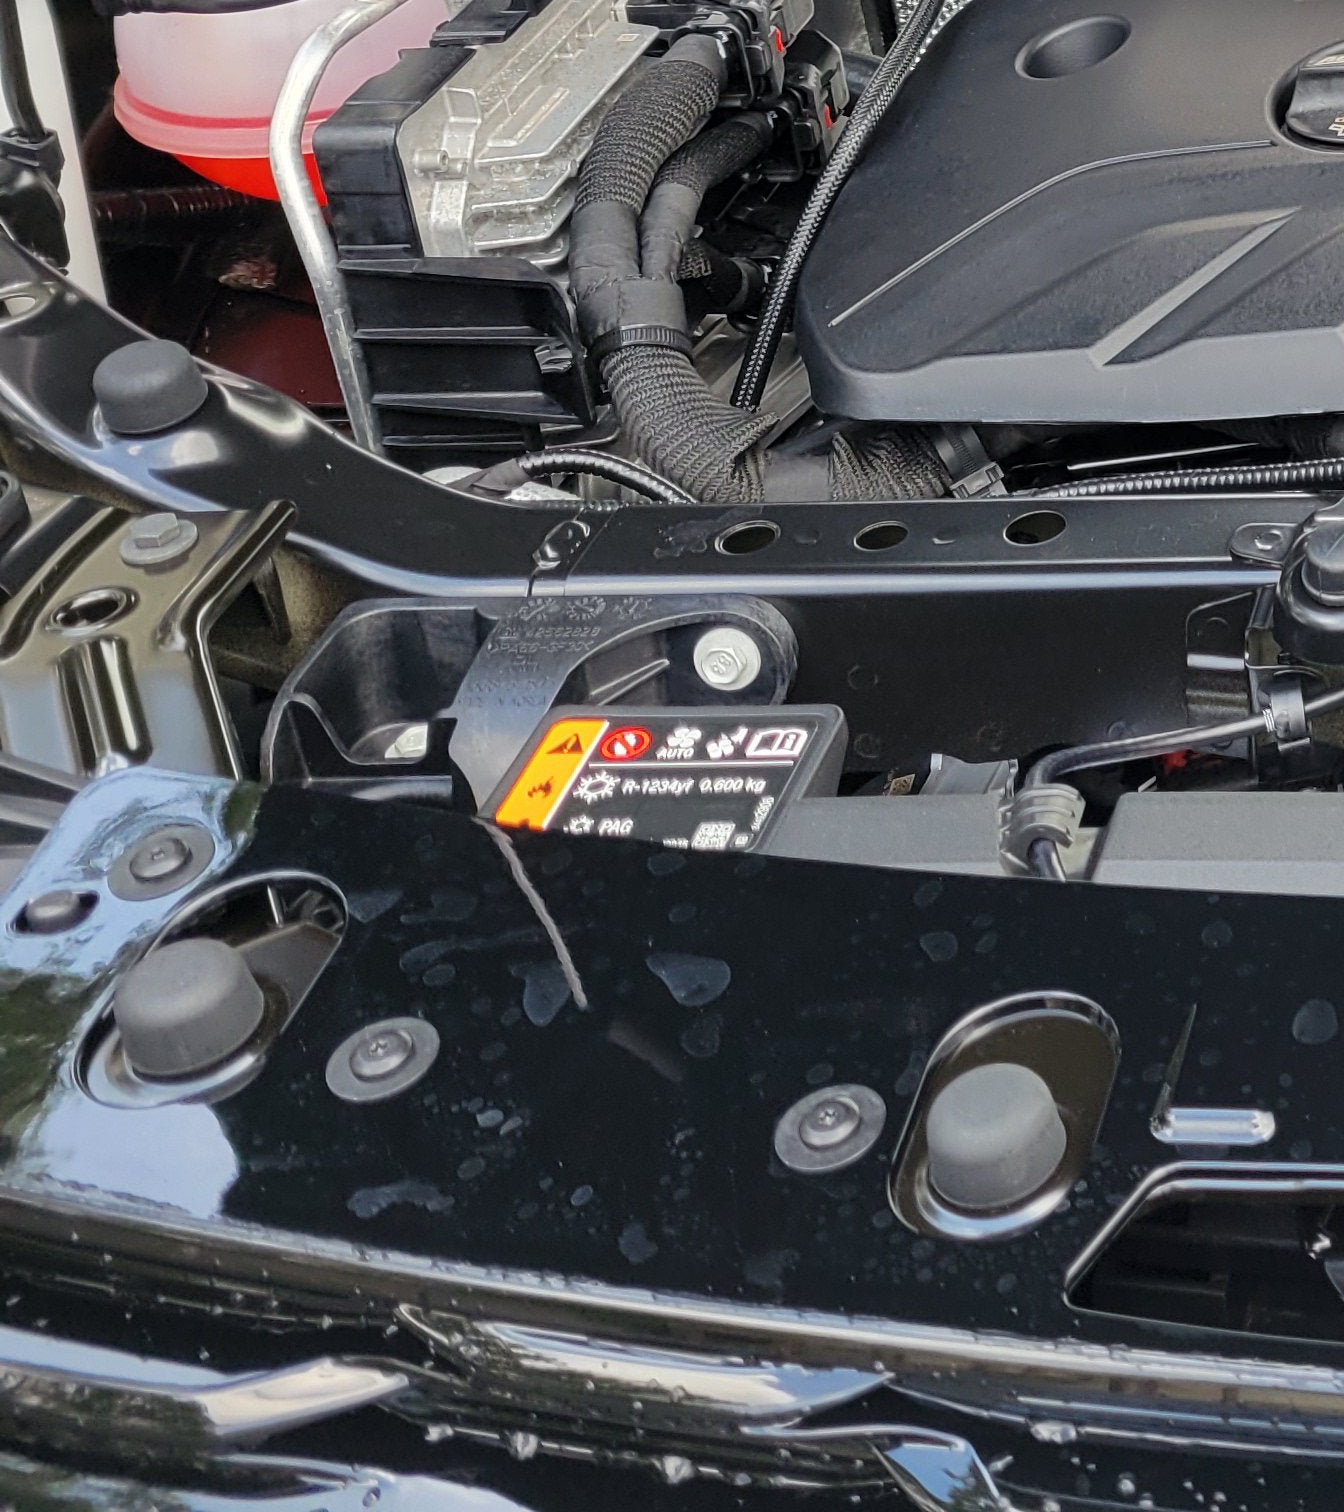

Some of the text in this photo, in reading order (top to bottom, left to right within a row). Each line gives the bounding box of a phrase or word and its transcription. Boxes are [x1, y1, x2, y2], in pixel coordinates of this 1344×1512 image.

[656, 748, 695, 760] AUTO
[622, 777, 767, 796] R-1234yf 0.600 kg
[598, 817, 634, 837] PAG
